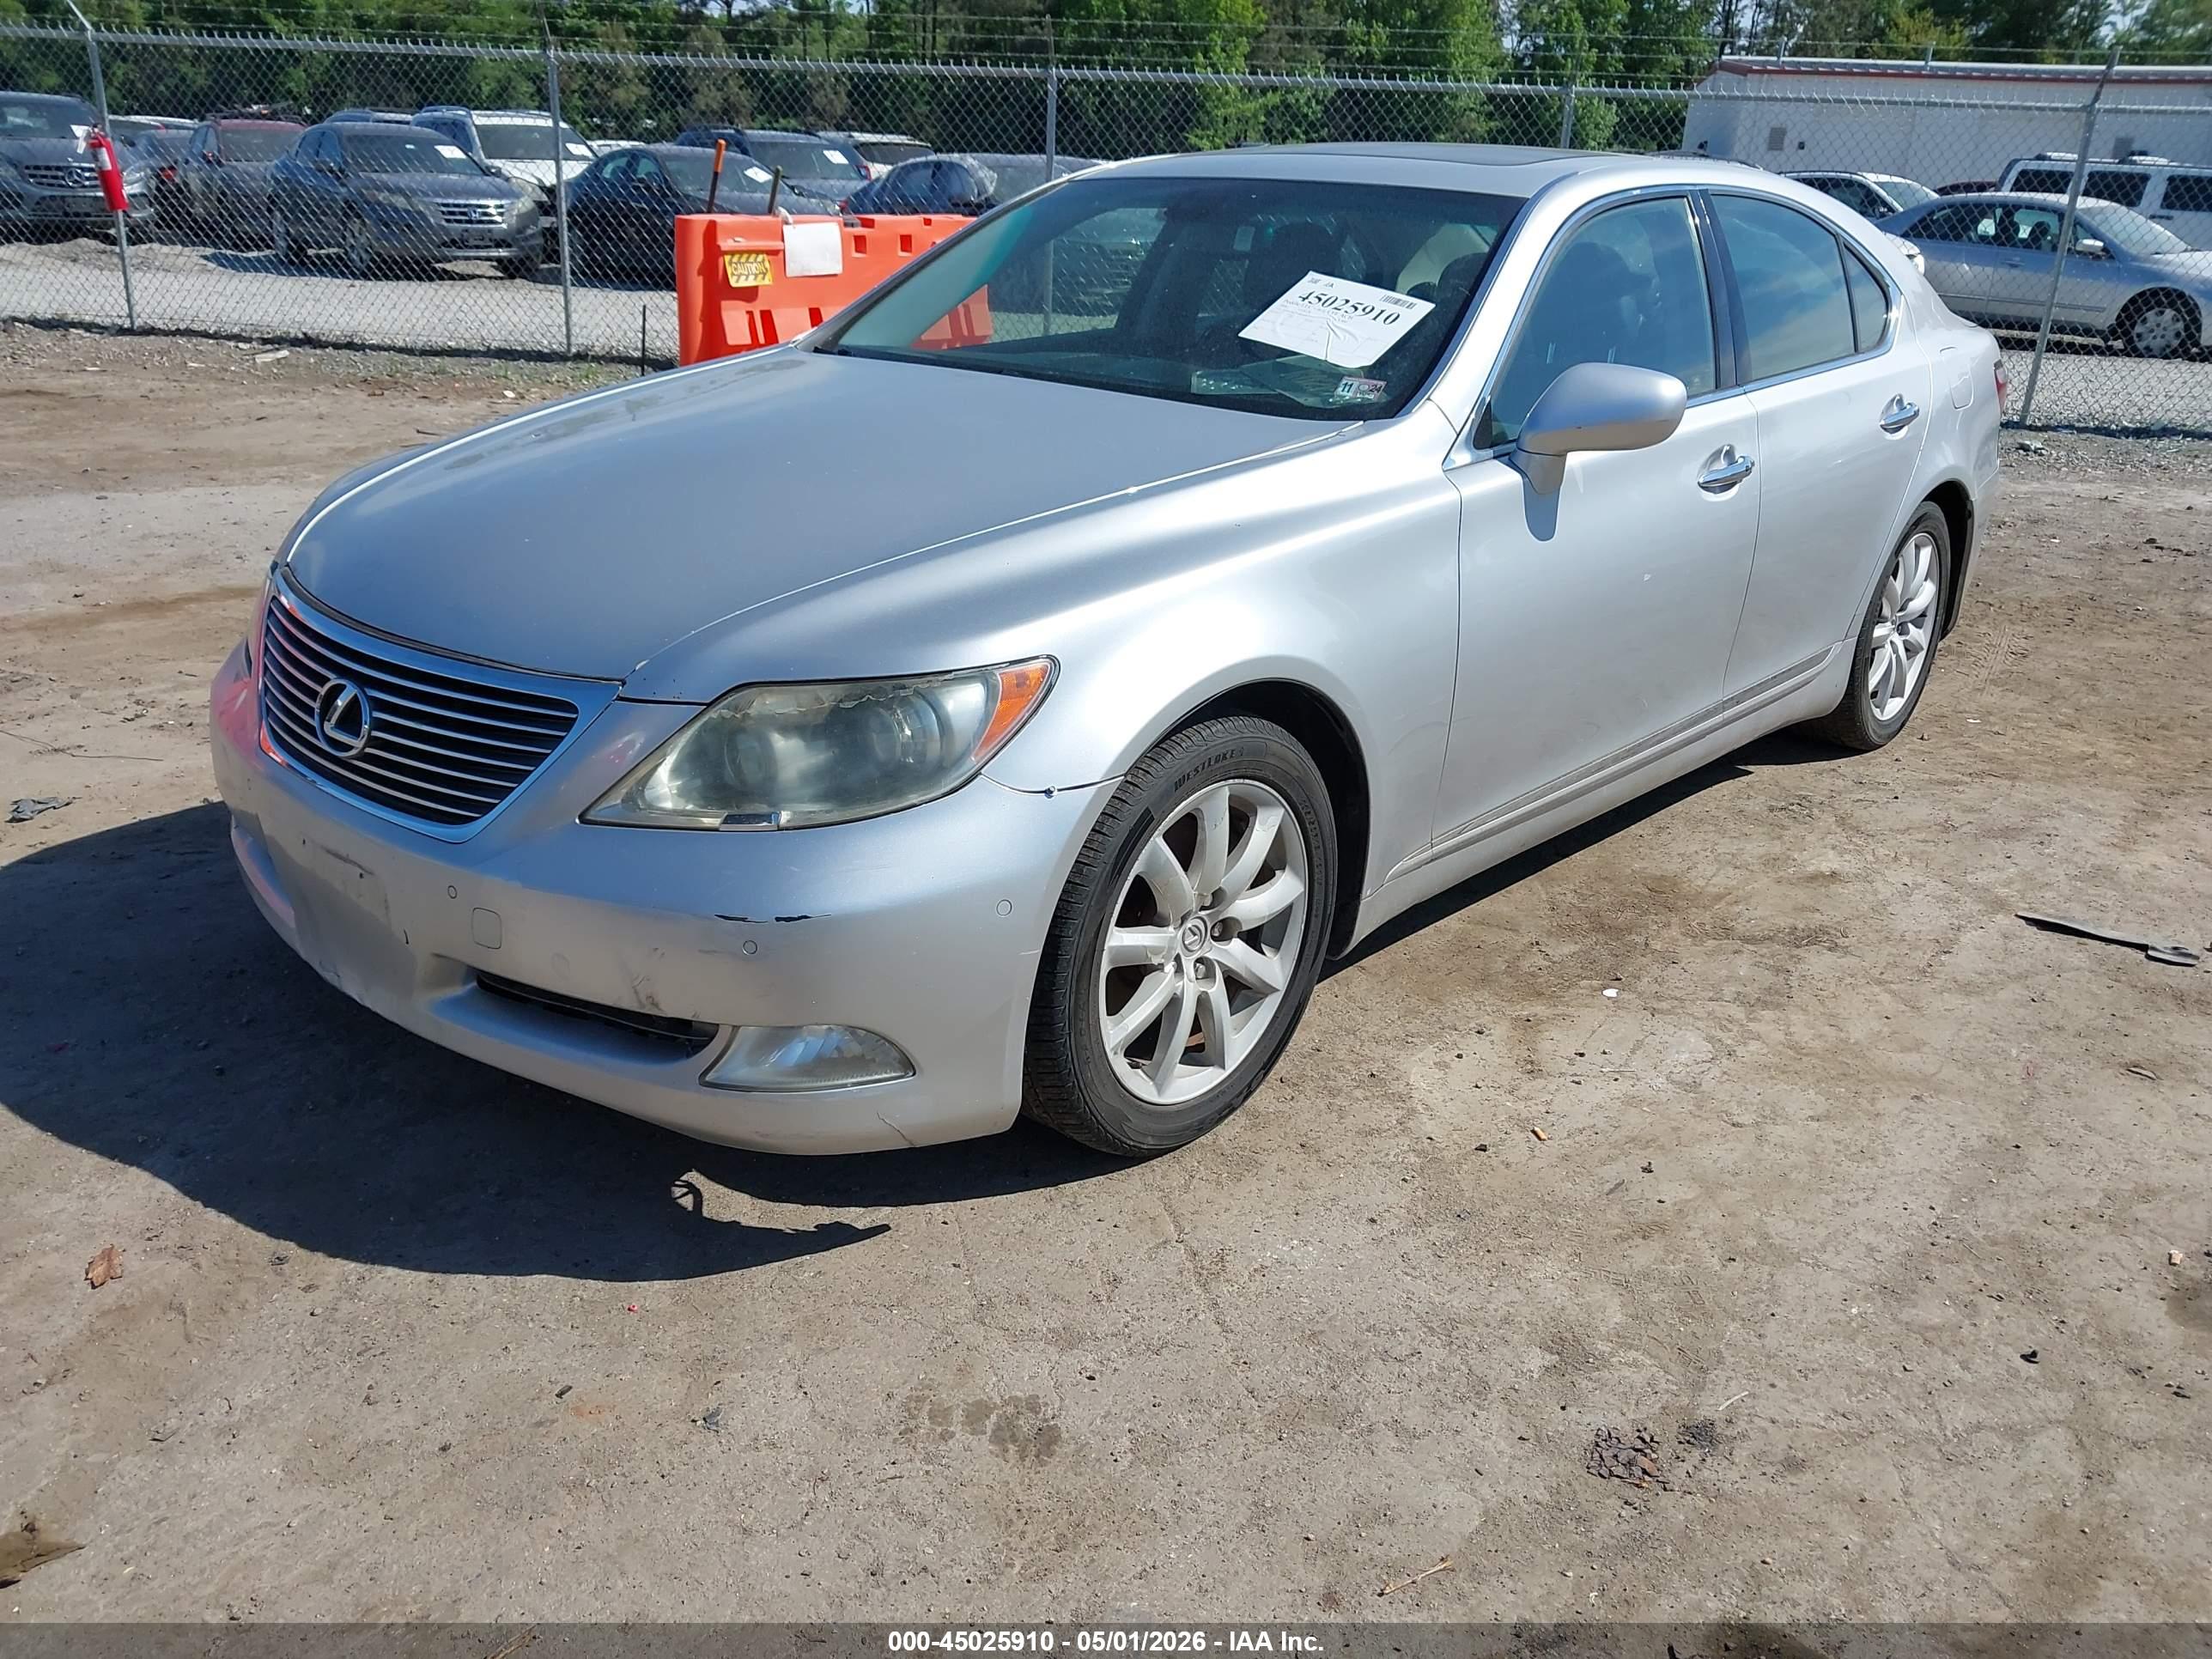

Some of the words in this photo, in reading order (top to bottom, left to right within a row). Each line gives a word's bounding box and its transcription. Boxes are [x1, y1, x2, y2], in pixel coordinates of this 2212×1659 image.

[731, 261, 767, 276] CAUTION
[1297, 289, 1401, 326] 45025910
[1341, 381, 1354, 393] 11
[1369, 384, 1383, 393] 24
